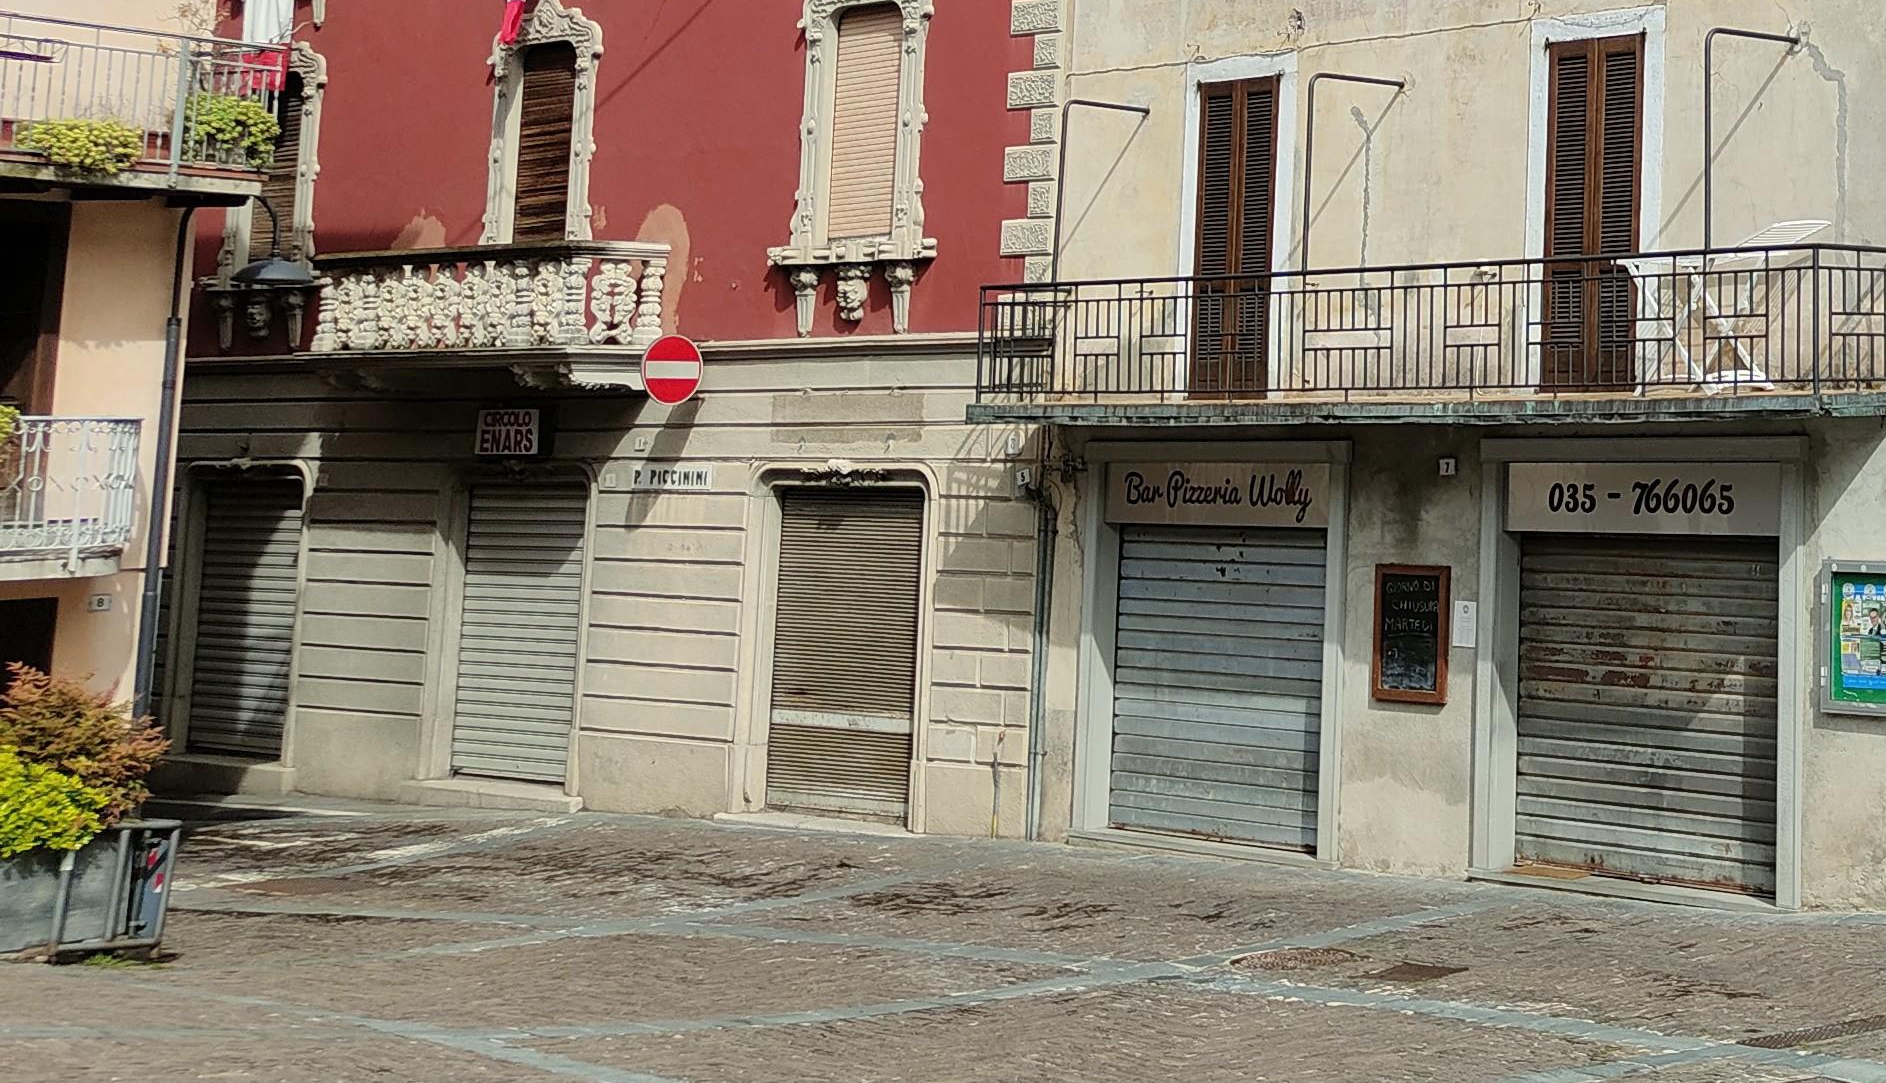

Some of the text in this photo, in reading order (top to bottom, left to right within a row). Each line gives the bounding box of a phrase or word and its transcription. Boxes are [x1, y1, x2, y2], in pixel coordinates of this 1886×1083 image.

[484, 410, 532, 427] CIRCOLO
[479, 427, 533, 453] ENARS
[633, 469, 642, 485] P.
[649, 469, 708, 486] PICCININI
[1125, 469, 1312, 524] Bar Pizzeria Wolly
[1548, 482, 1596, 513] 035
[1632, 478, 1735, 515] 766065
[1423, 580, 1435, 592] DI
[96, 597, 105, 608] 8
